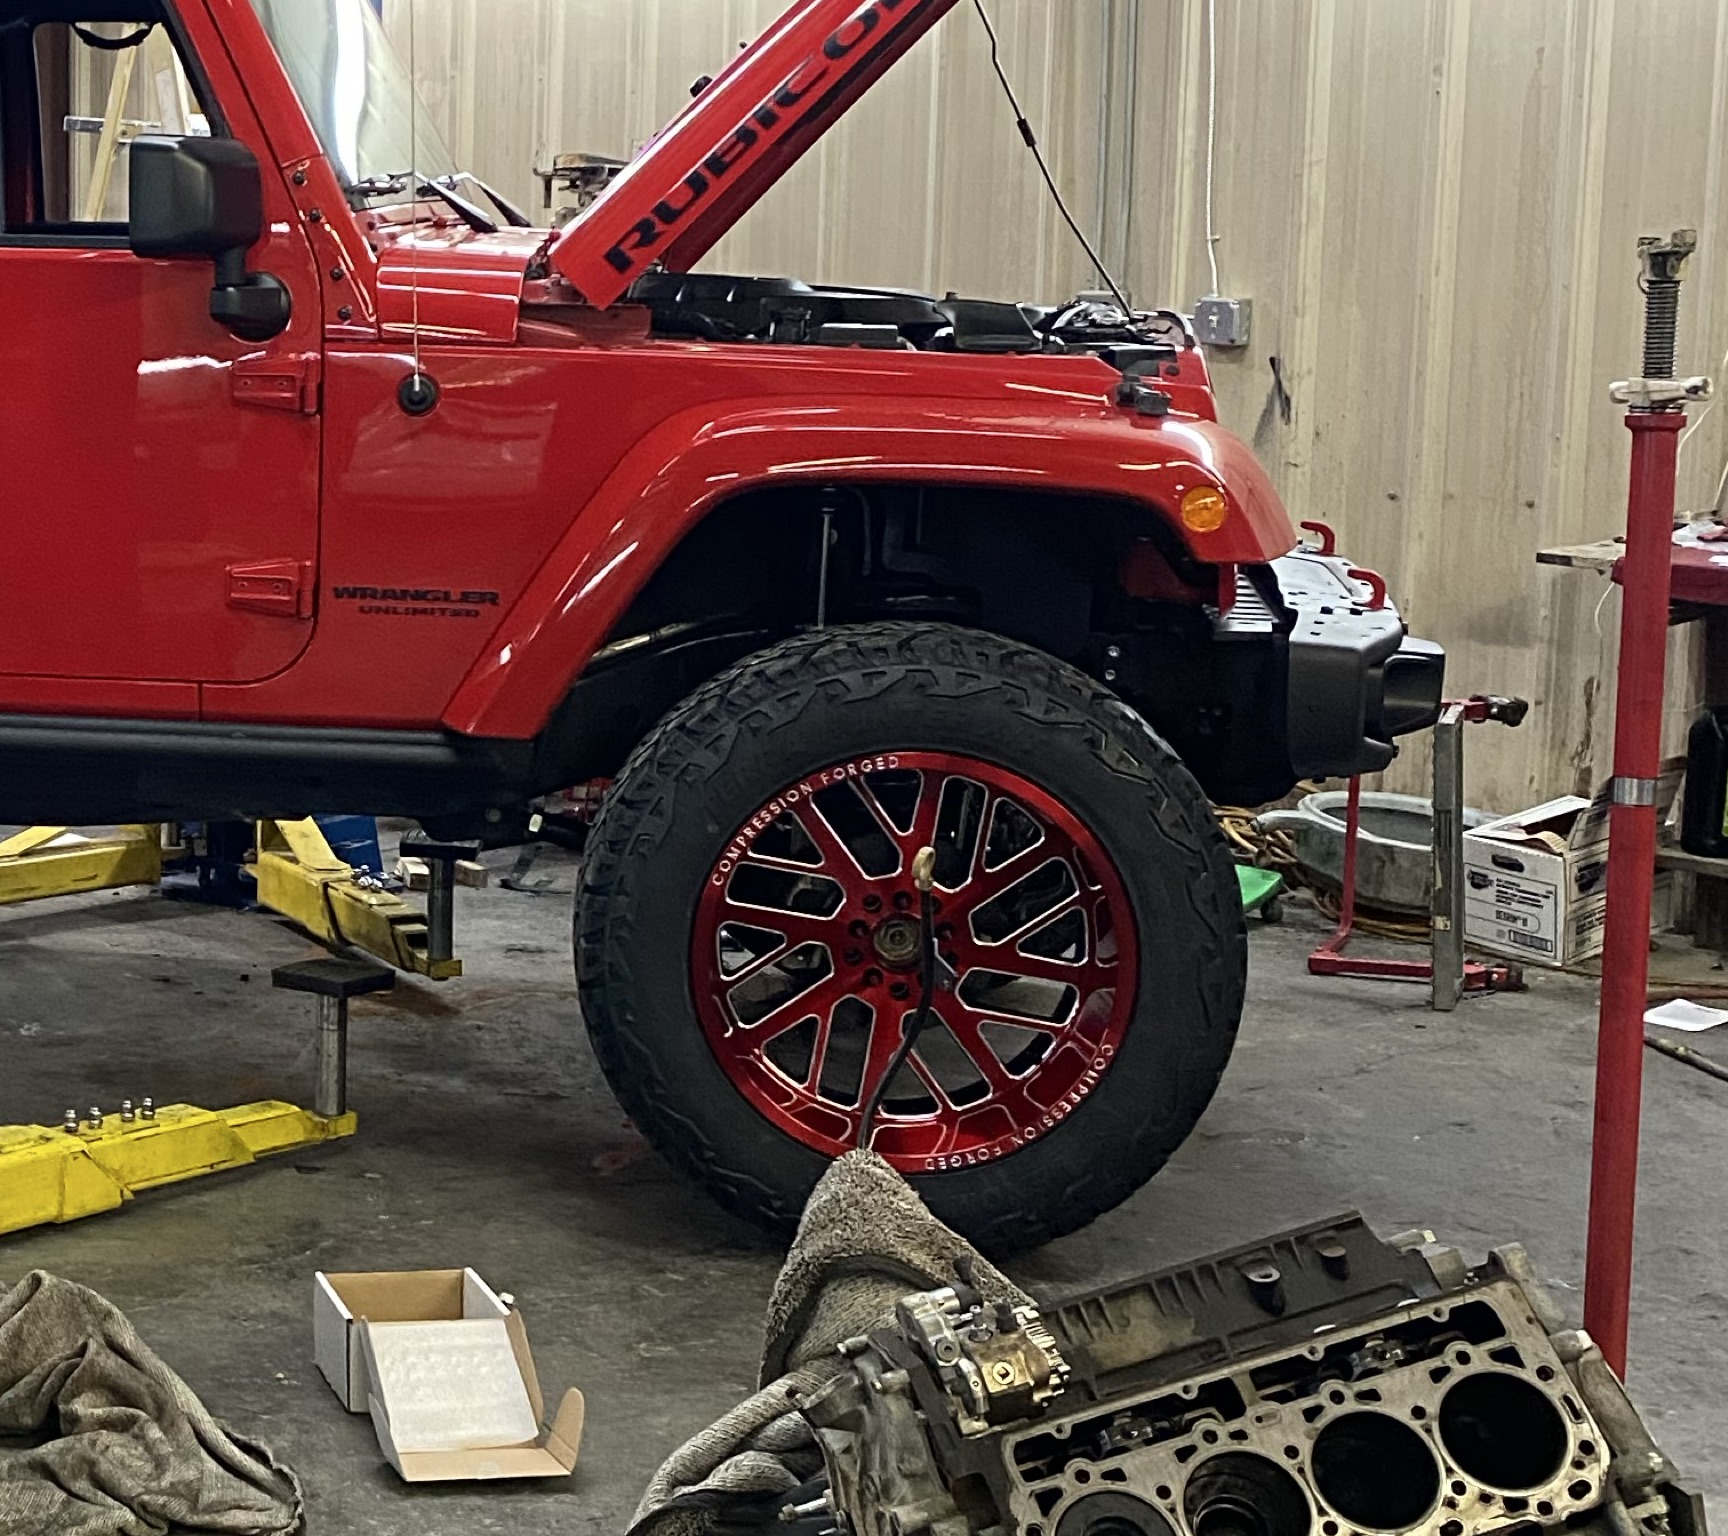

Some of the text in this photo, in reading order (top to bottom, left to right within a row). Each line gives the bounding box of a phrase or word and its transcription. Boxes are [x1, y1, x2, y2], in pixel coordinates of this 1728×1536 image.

[332, 586, 500, 606] WRANGLER
[358, 605, 480, 617] UNLIMITED
[712, 756, 899, 886] COMPRESSION FORGED
[924, 1044, 1115, 1171] COMPRESSION FORGED
